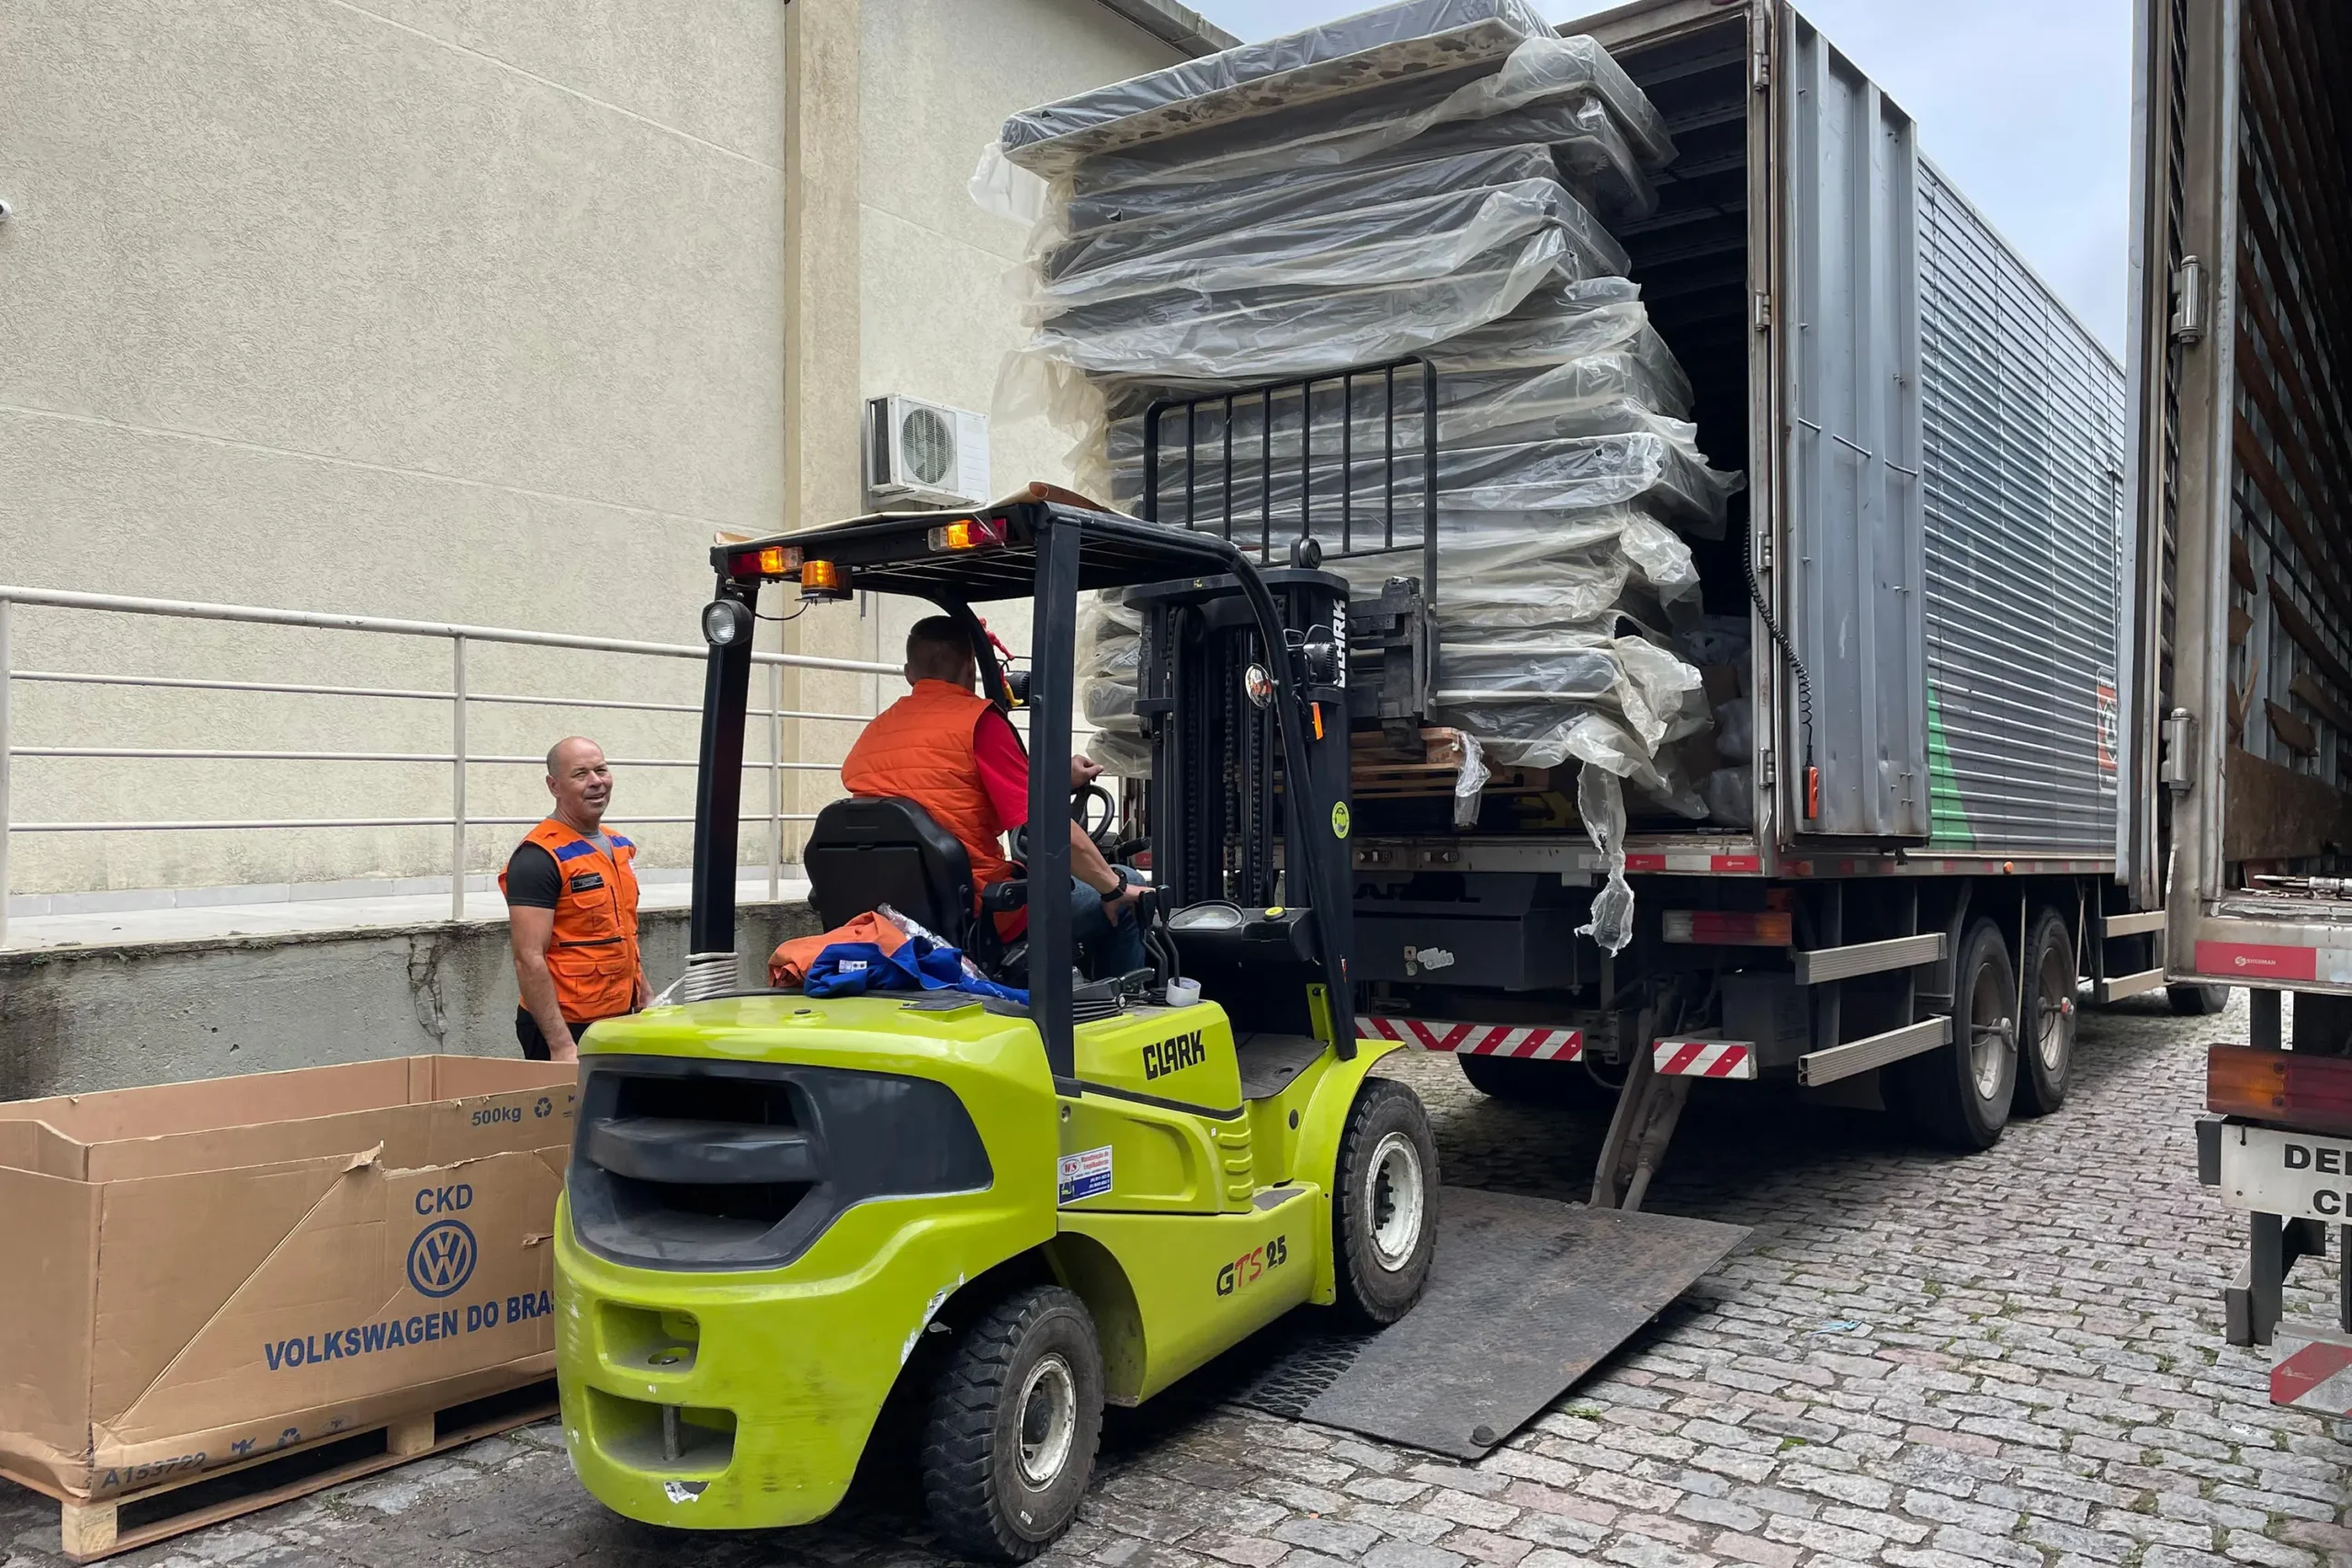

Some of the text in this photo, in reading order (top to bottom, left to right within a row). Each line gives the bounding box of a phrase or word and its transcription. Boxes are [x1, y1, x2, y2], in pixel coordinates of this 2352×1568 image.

[1142, 1030, 1205, 1080] CLARK
[471, 1107, 521, 1126] 500kg
[2284, 1144, 2352, 1176] DE
[415, 1184, 473, 1215] CKD
[1216, 1235, 1287, 1296] GTS 25
[265, 1290, 555, 1371] VOLKSWAGEN DO BRA
